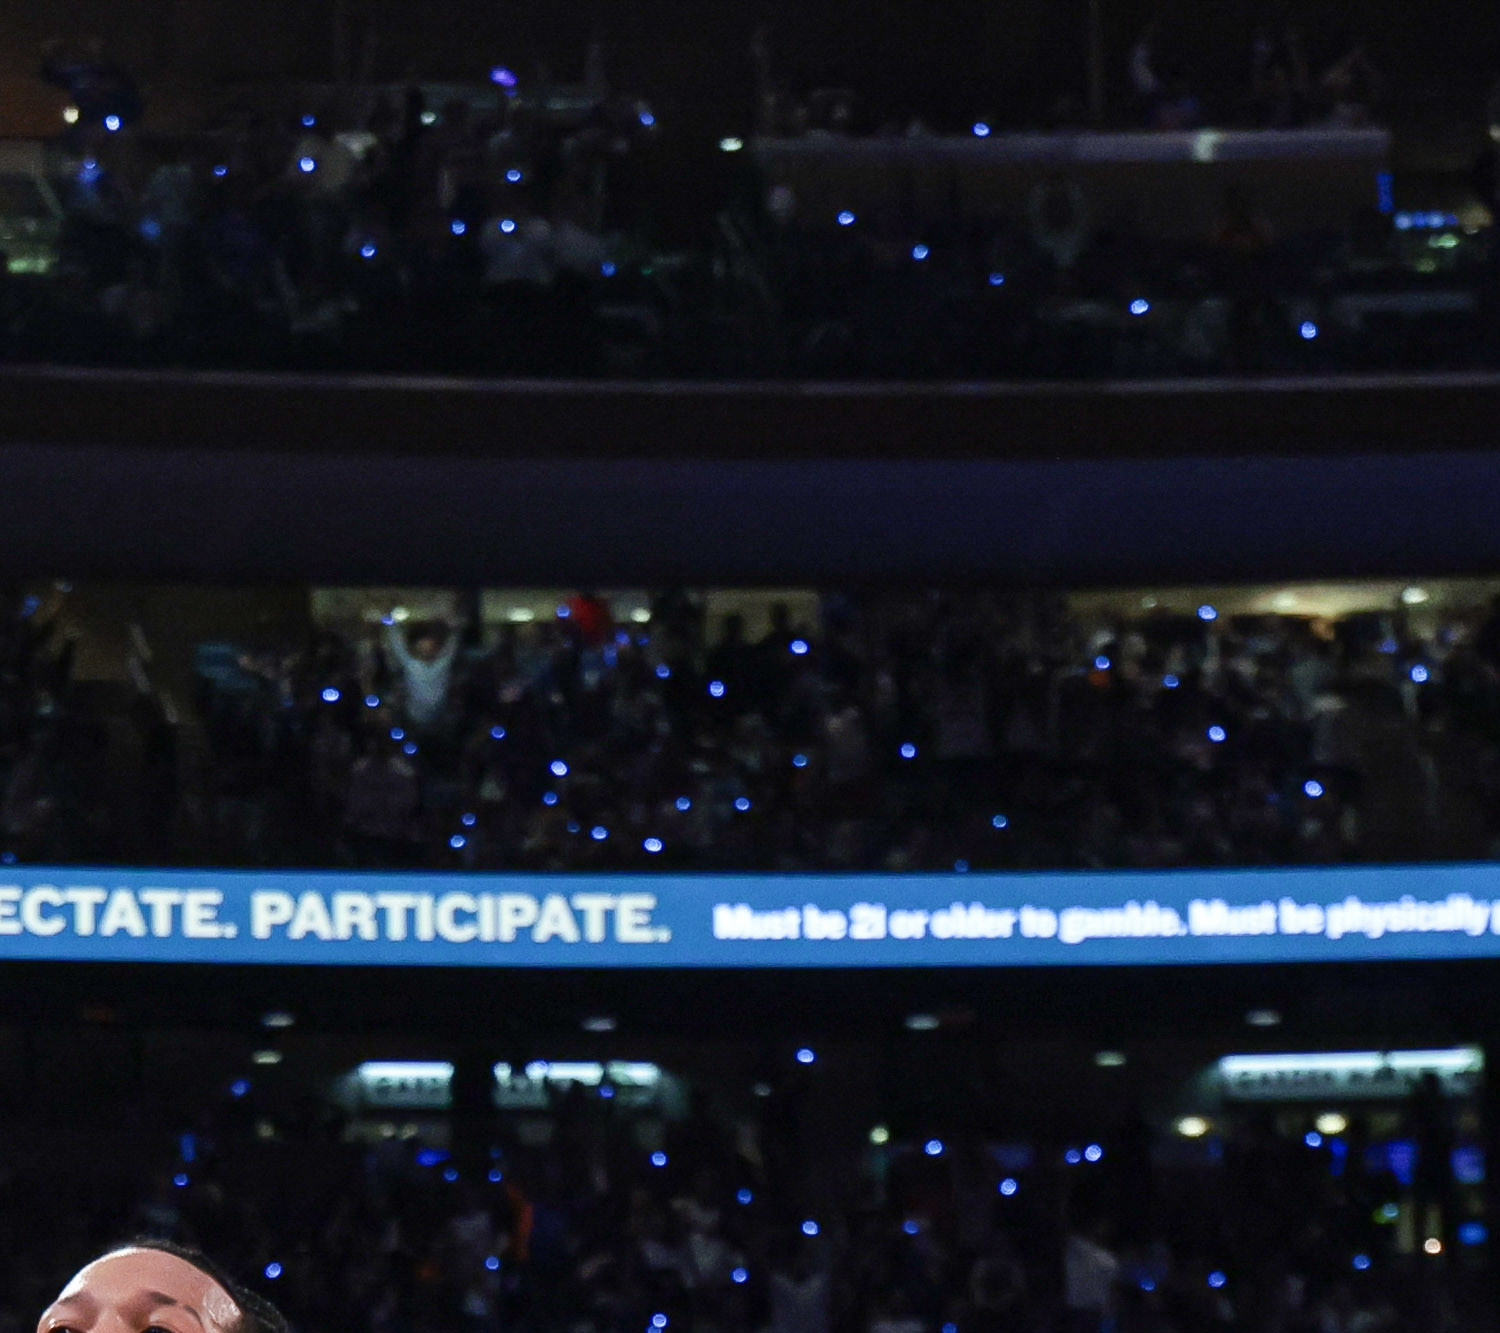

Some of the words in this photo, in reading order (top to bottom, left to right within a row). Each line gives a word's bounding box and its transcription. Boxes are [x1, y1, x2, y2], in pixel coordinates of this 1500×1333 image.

[251, 890, 671, 944] PARTICIPATE.
[713, 903, 800, 939] Must
[803, 903, 847, 939] be
[1188, 898, 1276, 936] Must
[1278, 897, 1324, 936] be
